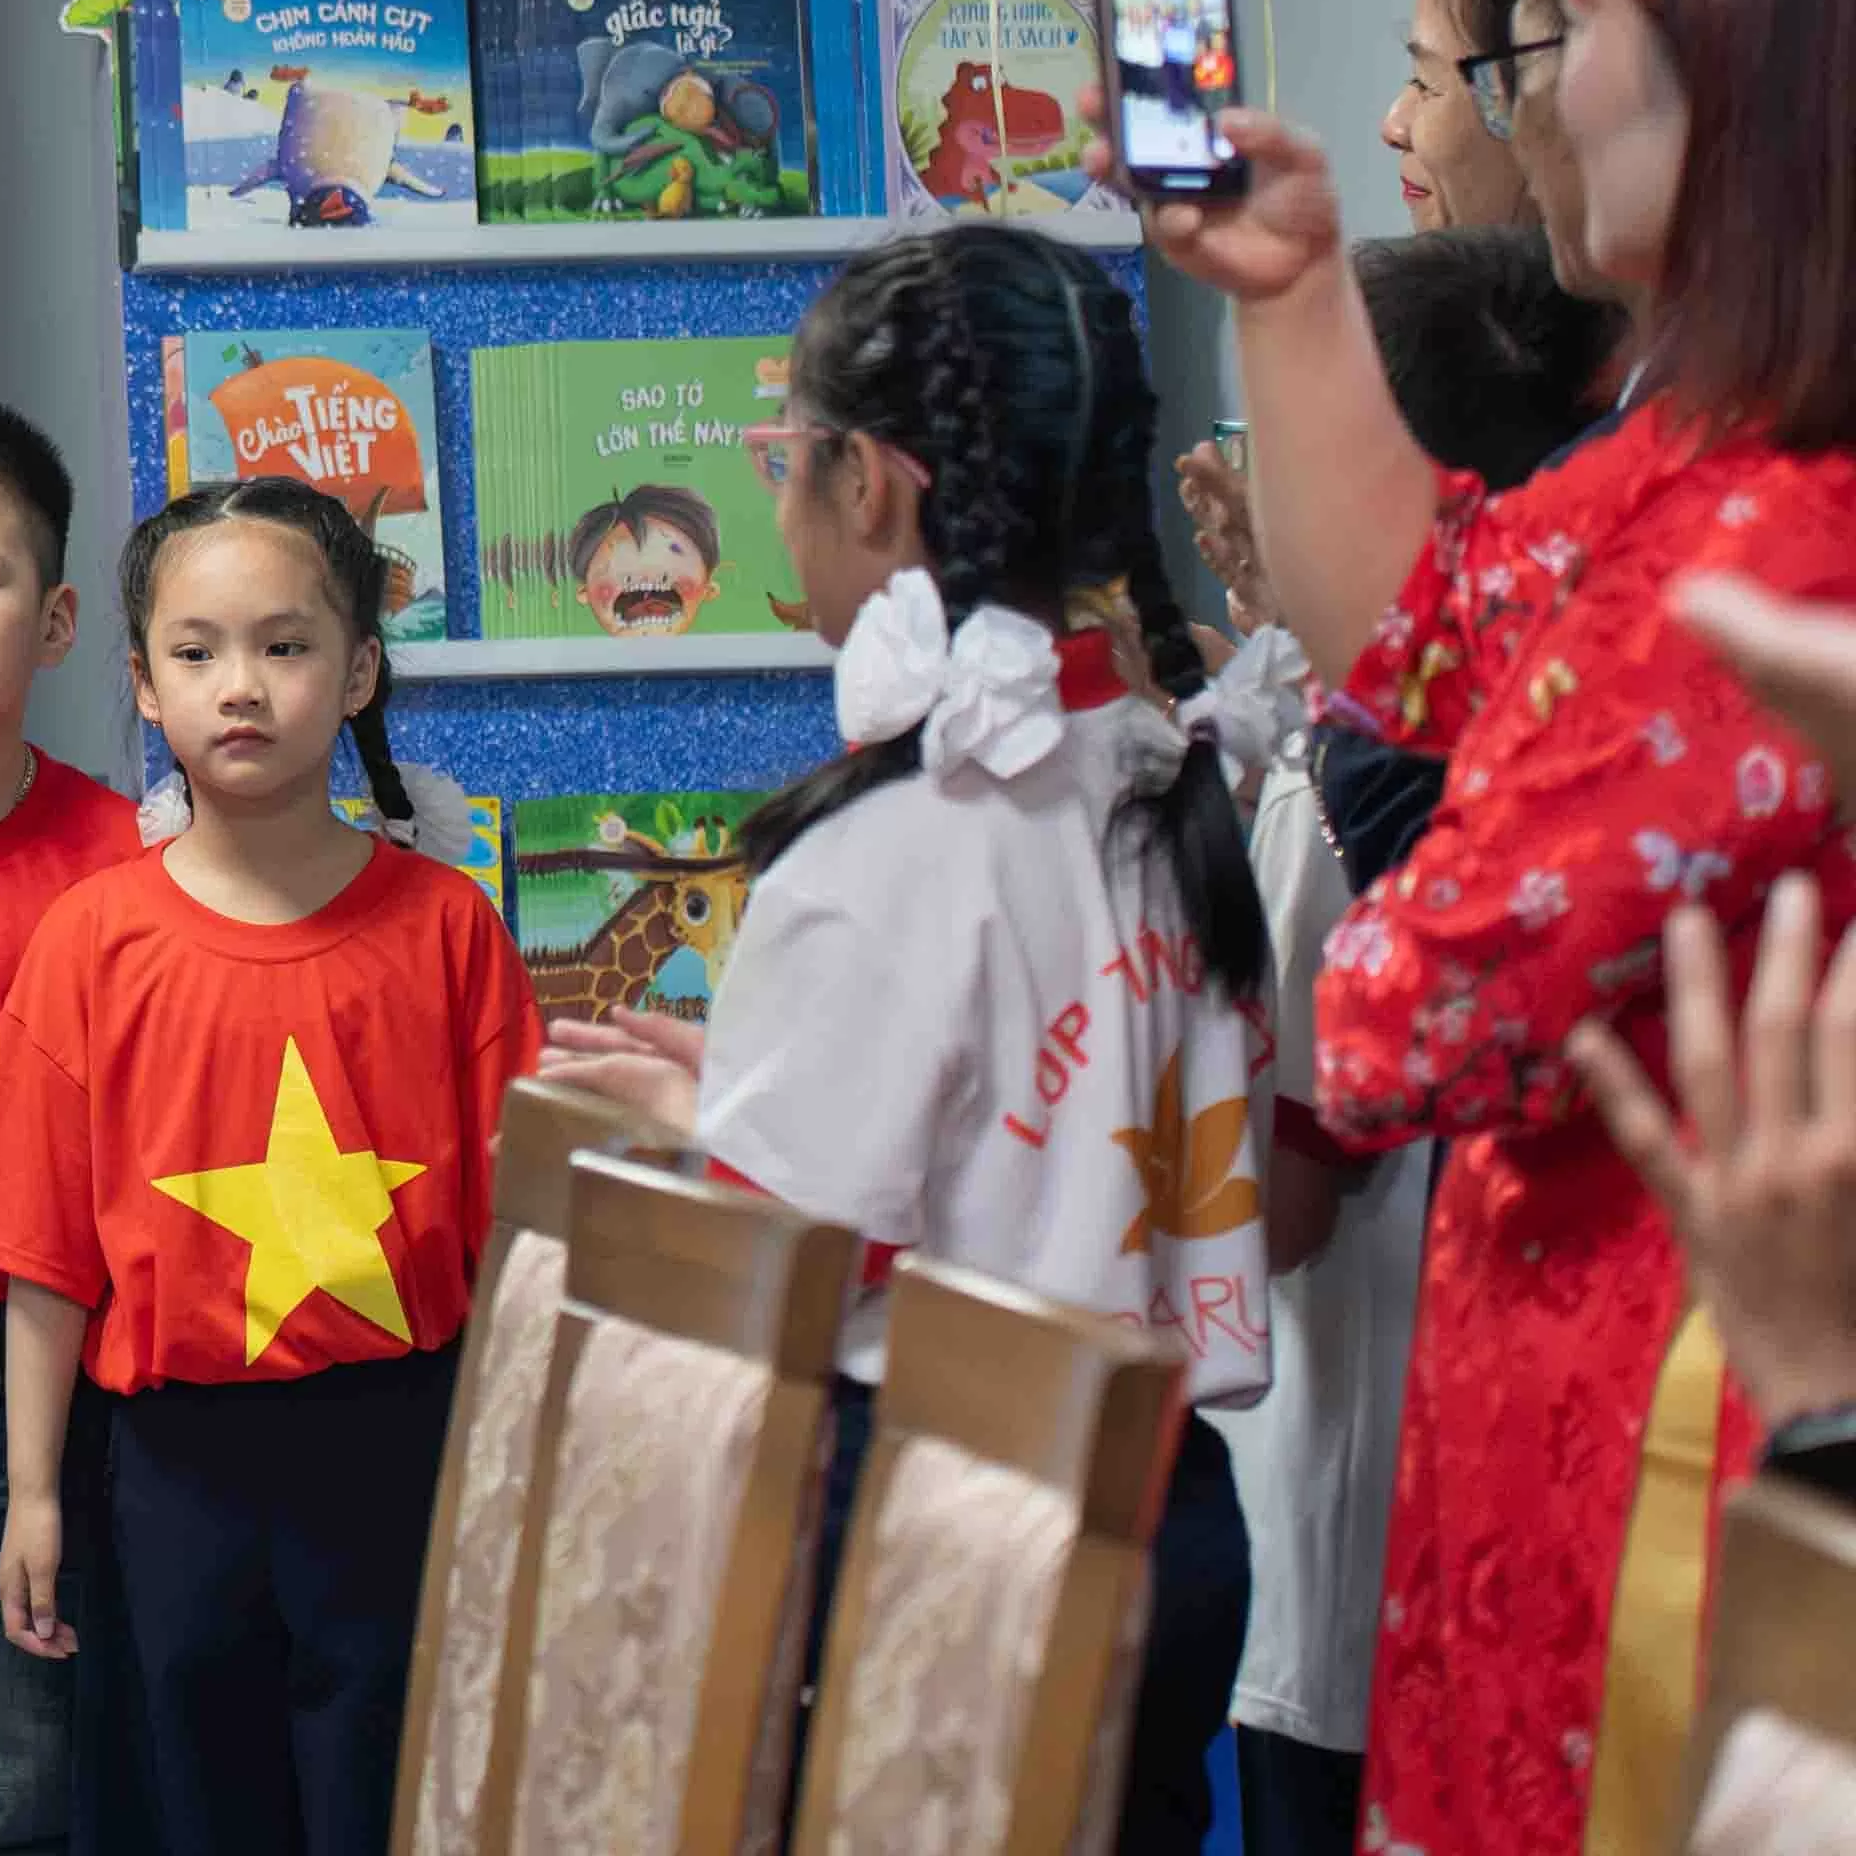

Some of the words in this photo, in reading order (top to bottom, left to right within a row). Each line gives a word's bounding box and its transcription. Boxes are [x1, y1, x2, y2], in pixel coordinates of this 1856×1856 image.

[255, 1, 311, 33] CHIM
[384, 5, 433, 35] CỤT
[272, 30, 326, 54] KHÔNG
[284, 379, 398, 433] TIẾNG
[620, 383, 666, 412] SAO
[238, 415, 303, 464] Chào
[287, 430, 377, 484] VIỆT
